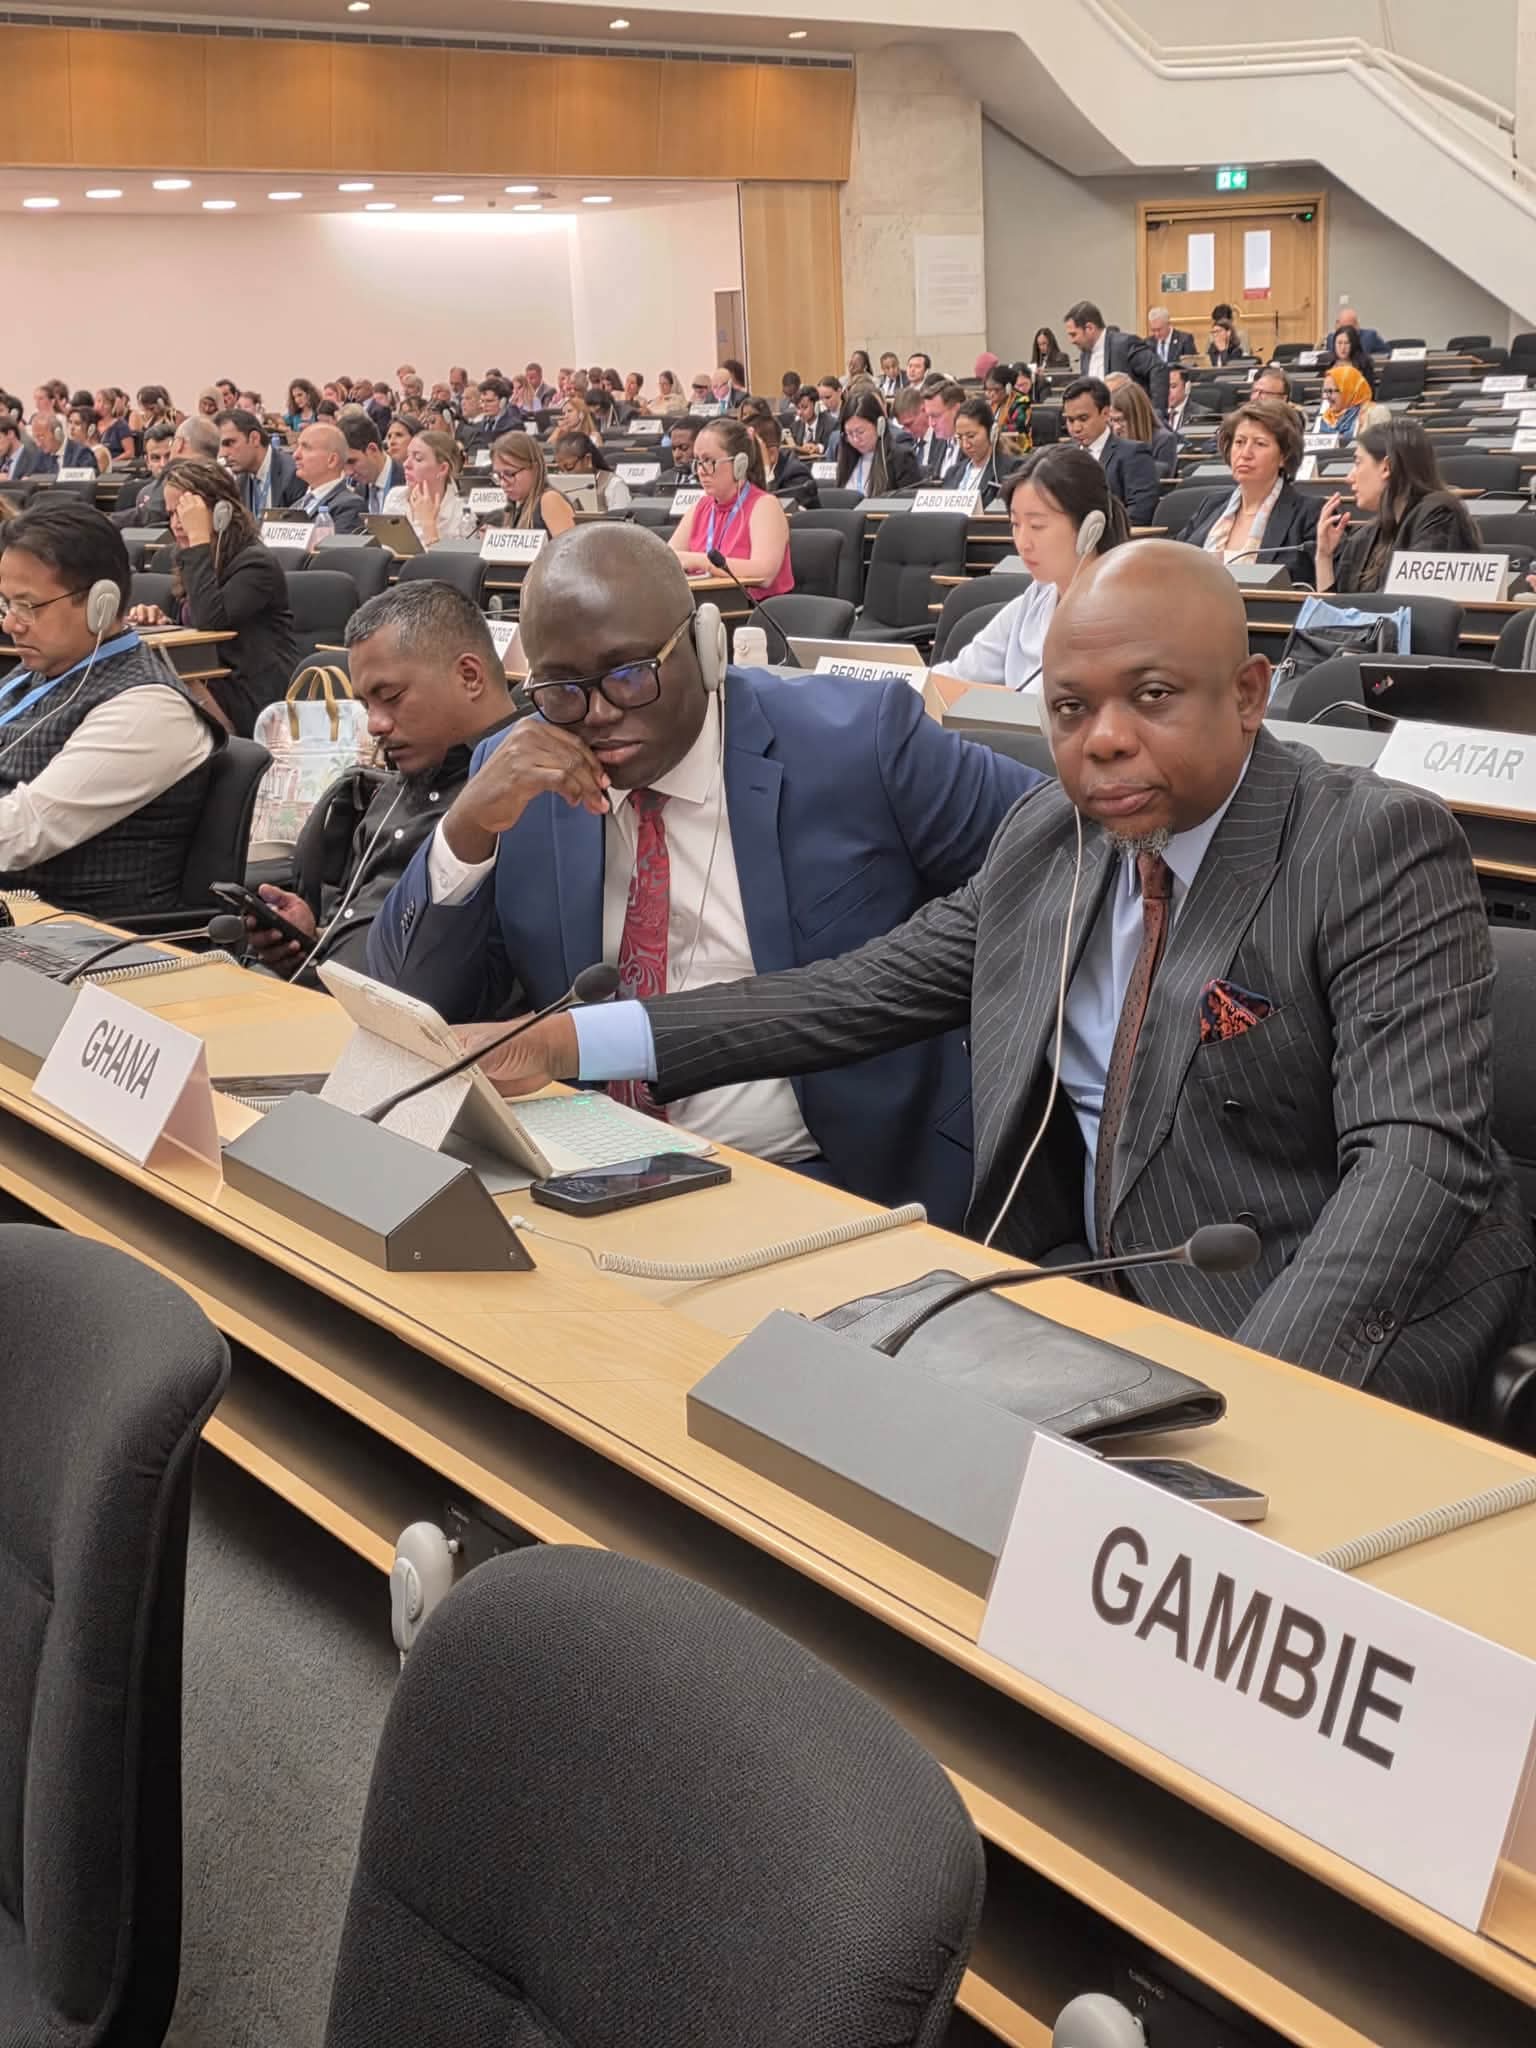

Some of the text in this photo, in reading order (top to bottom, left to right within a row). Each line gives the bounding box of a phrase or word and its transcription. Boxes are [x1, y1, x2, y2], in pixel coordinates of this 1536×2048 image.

[916, 495, 975, 507] CABO VERDE
[265, 526, 308, 541] AUTRICHE
[486, 533, 541, 548] AUSTRALIE
[1395, 559, 1499, 582] ARGENTINE
[1423, 740, 1525, 781] QATAR
[81, 1019, 161, 1100] GHANA
[1091, 1525, 1417, 1771] GAMBIE
